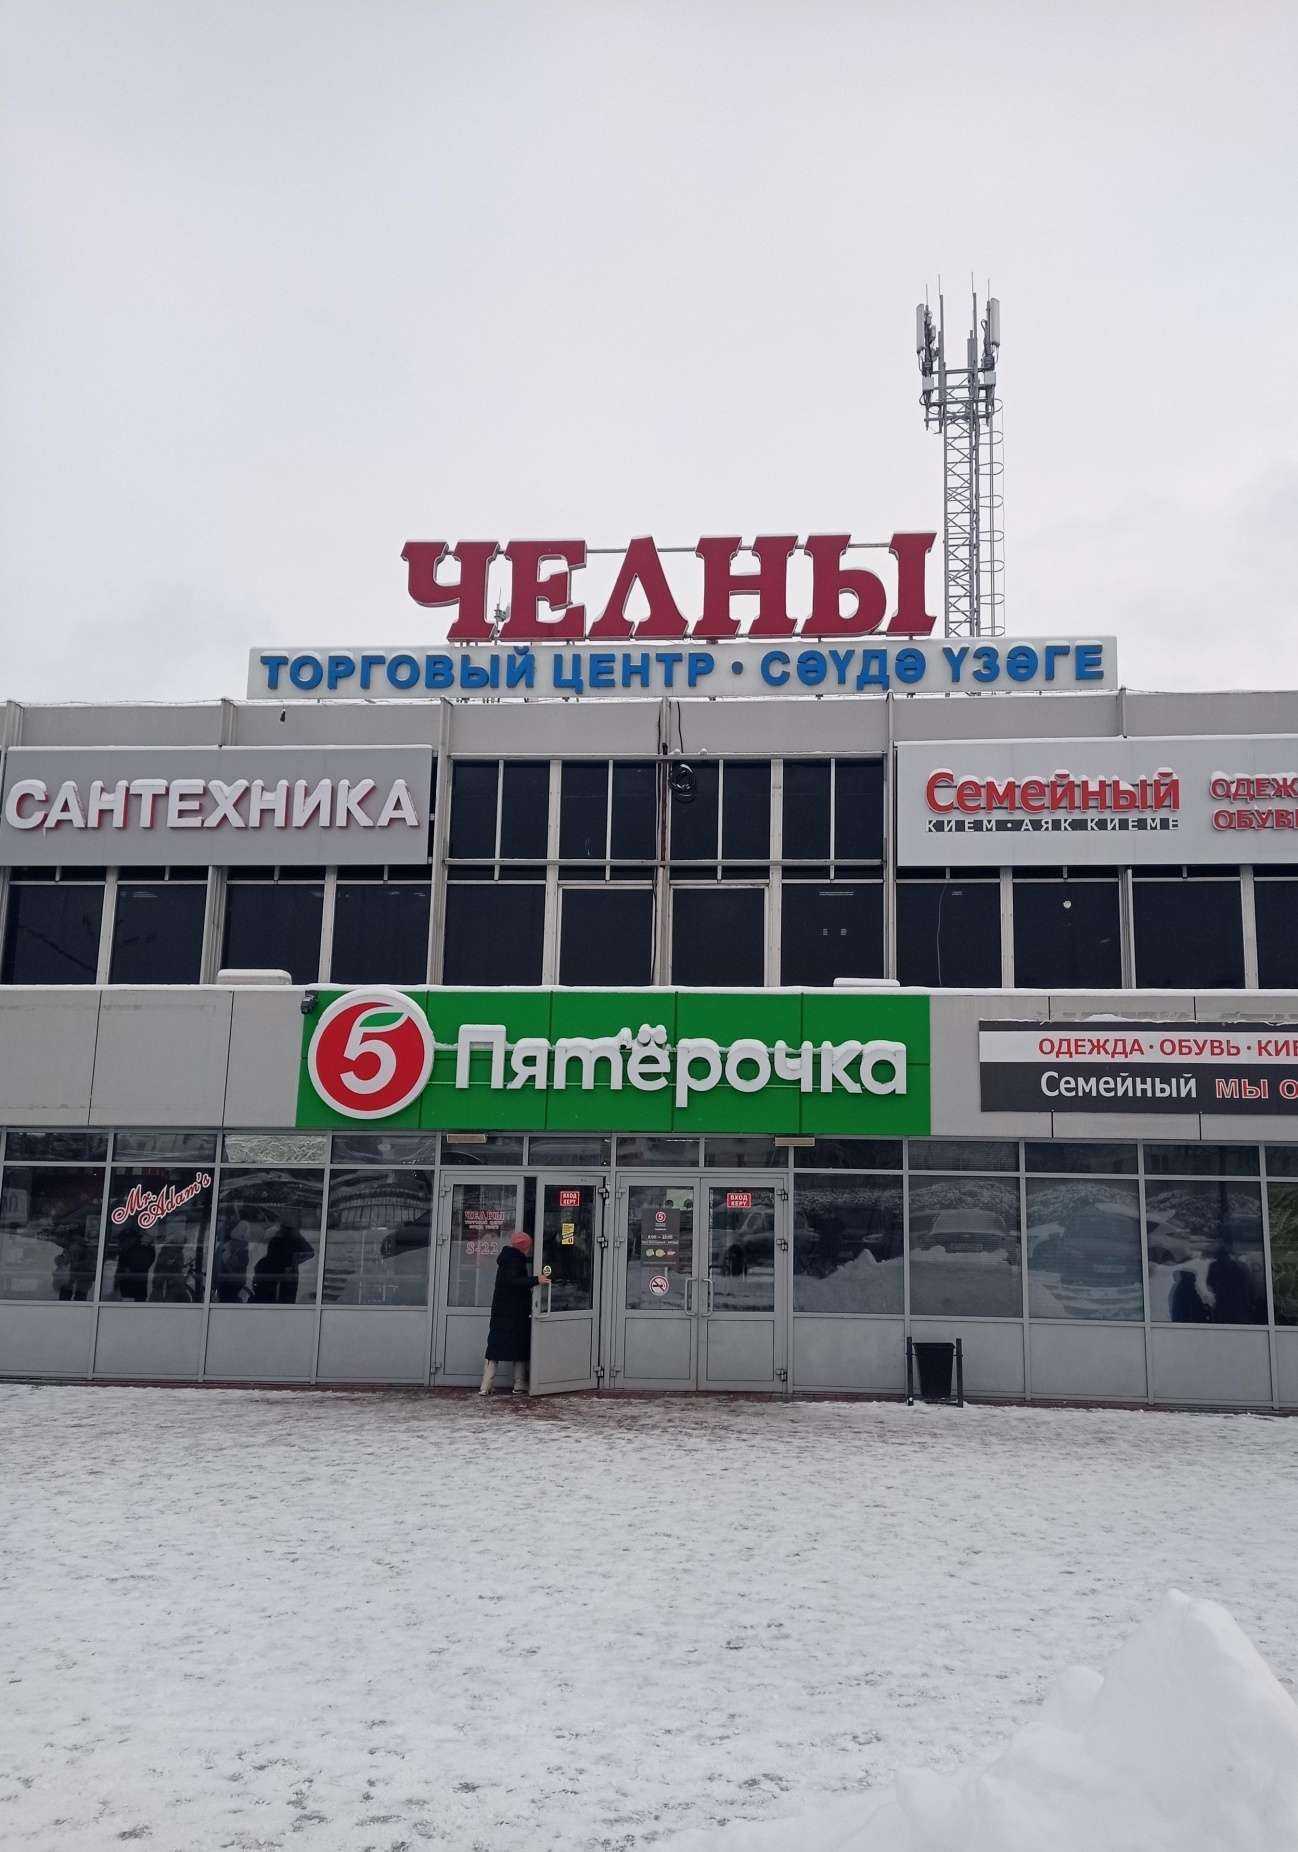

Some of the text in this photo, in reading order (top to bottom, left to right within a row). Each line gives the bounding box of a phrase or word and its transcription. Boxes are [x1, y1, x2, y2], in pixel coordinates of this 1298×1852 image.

[400, 532, 938, 642] ЧЕЛНЫ
[260, 646, 535, 690] ТОРГОВЫЙ
[553, 652, 715, 694] ЦЕНТР
[5, 779, 420, 829] САНТЕХНИКА
[926, 768, 1181, 814] Семейный
[927, 818, 1182, 832] КИЕМ АЯК КИЕМЕ
[456, 1024, 907, 1108] Пятёрочка
[1038, 1038, 1144, 1058] ОДЕЖДА
[1159, 1039, 1241, 1057] ОБУВЬ
[1040, 1071, 1197, 1098] Семейный
[1215, 1078, 1269, 1099] МЫ
[111, 1172, 211, 1229] Mr. Adam's
